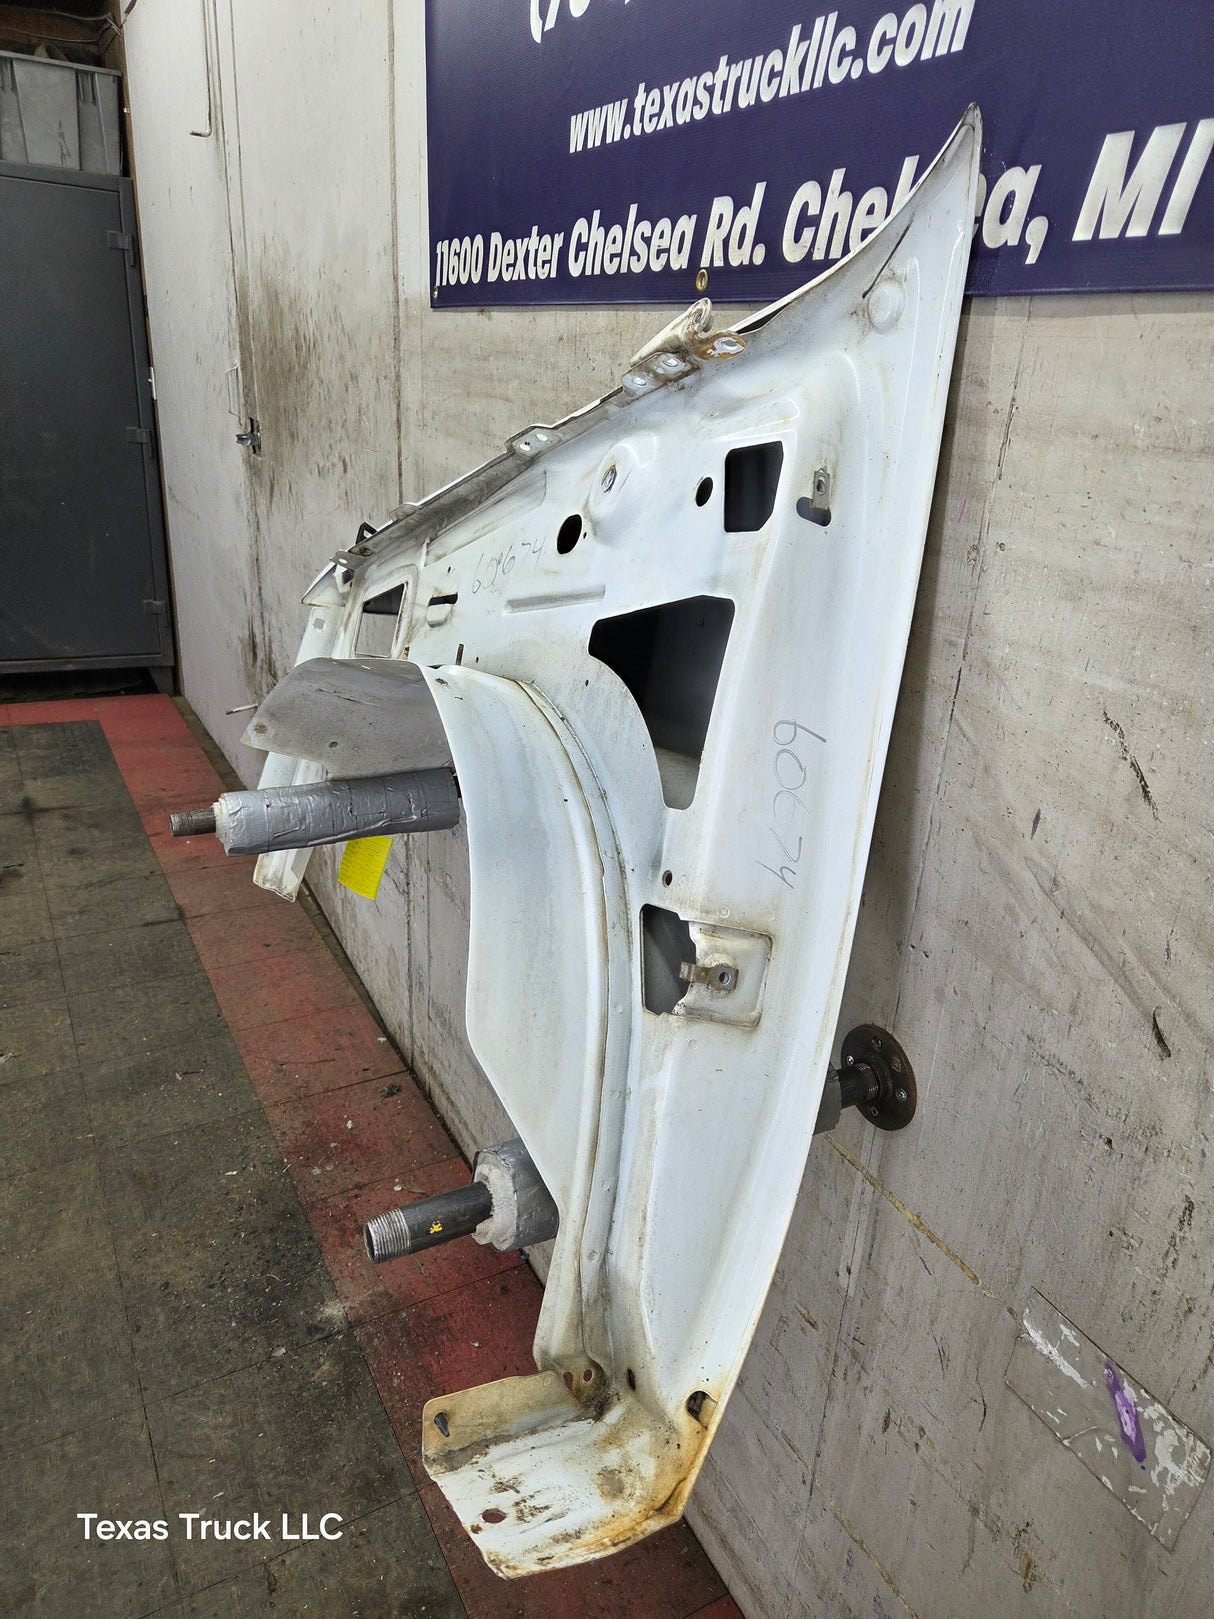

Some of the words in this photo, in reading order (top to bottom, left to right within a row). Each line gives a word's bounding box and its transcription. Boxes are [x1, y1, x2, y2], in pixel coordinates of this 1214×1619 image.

[569, 0, 976, 154] www.texastruckllc.com
[435, 233, 484, 287] 11600
[487, 225, 564, 283] Dexter
[568, 203, 698, 278] Chelsea
[701, 181, 767, 268] Rd.
[1071, 117, 1214, 242] MI
[754, 718, 828, 890] 60674
